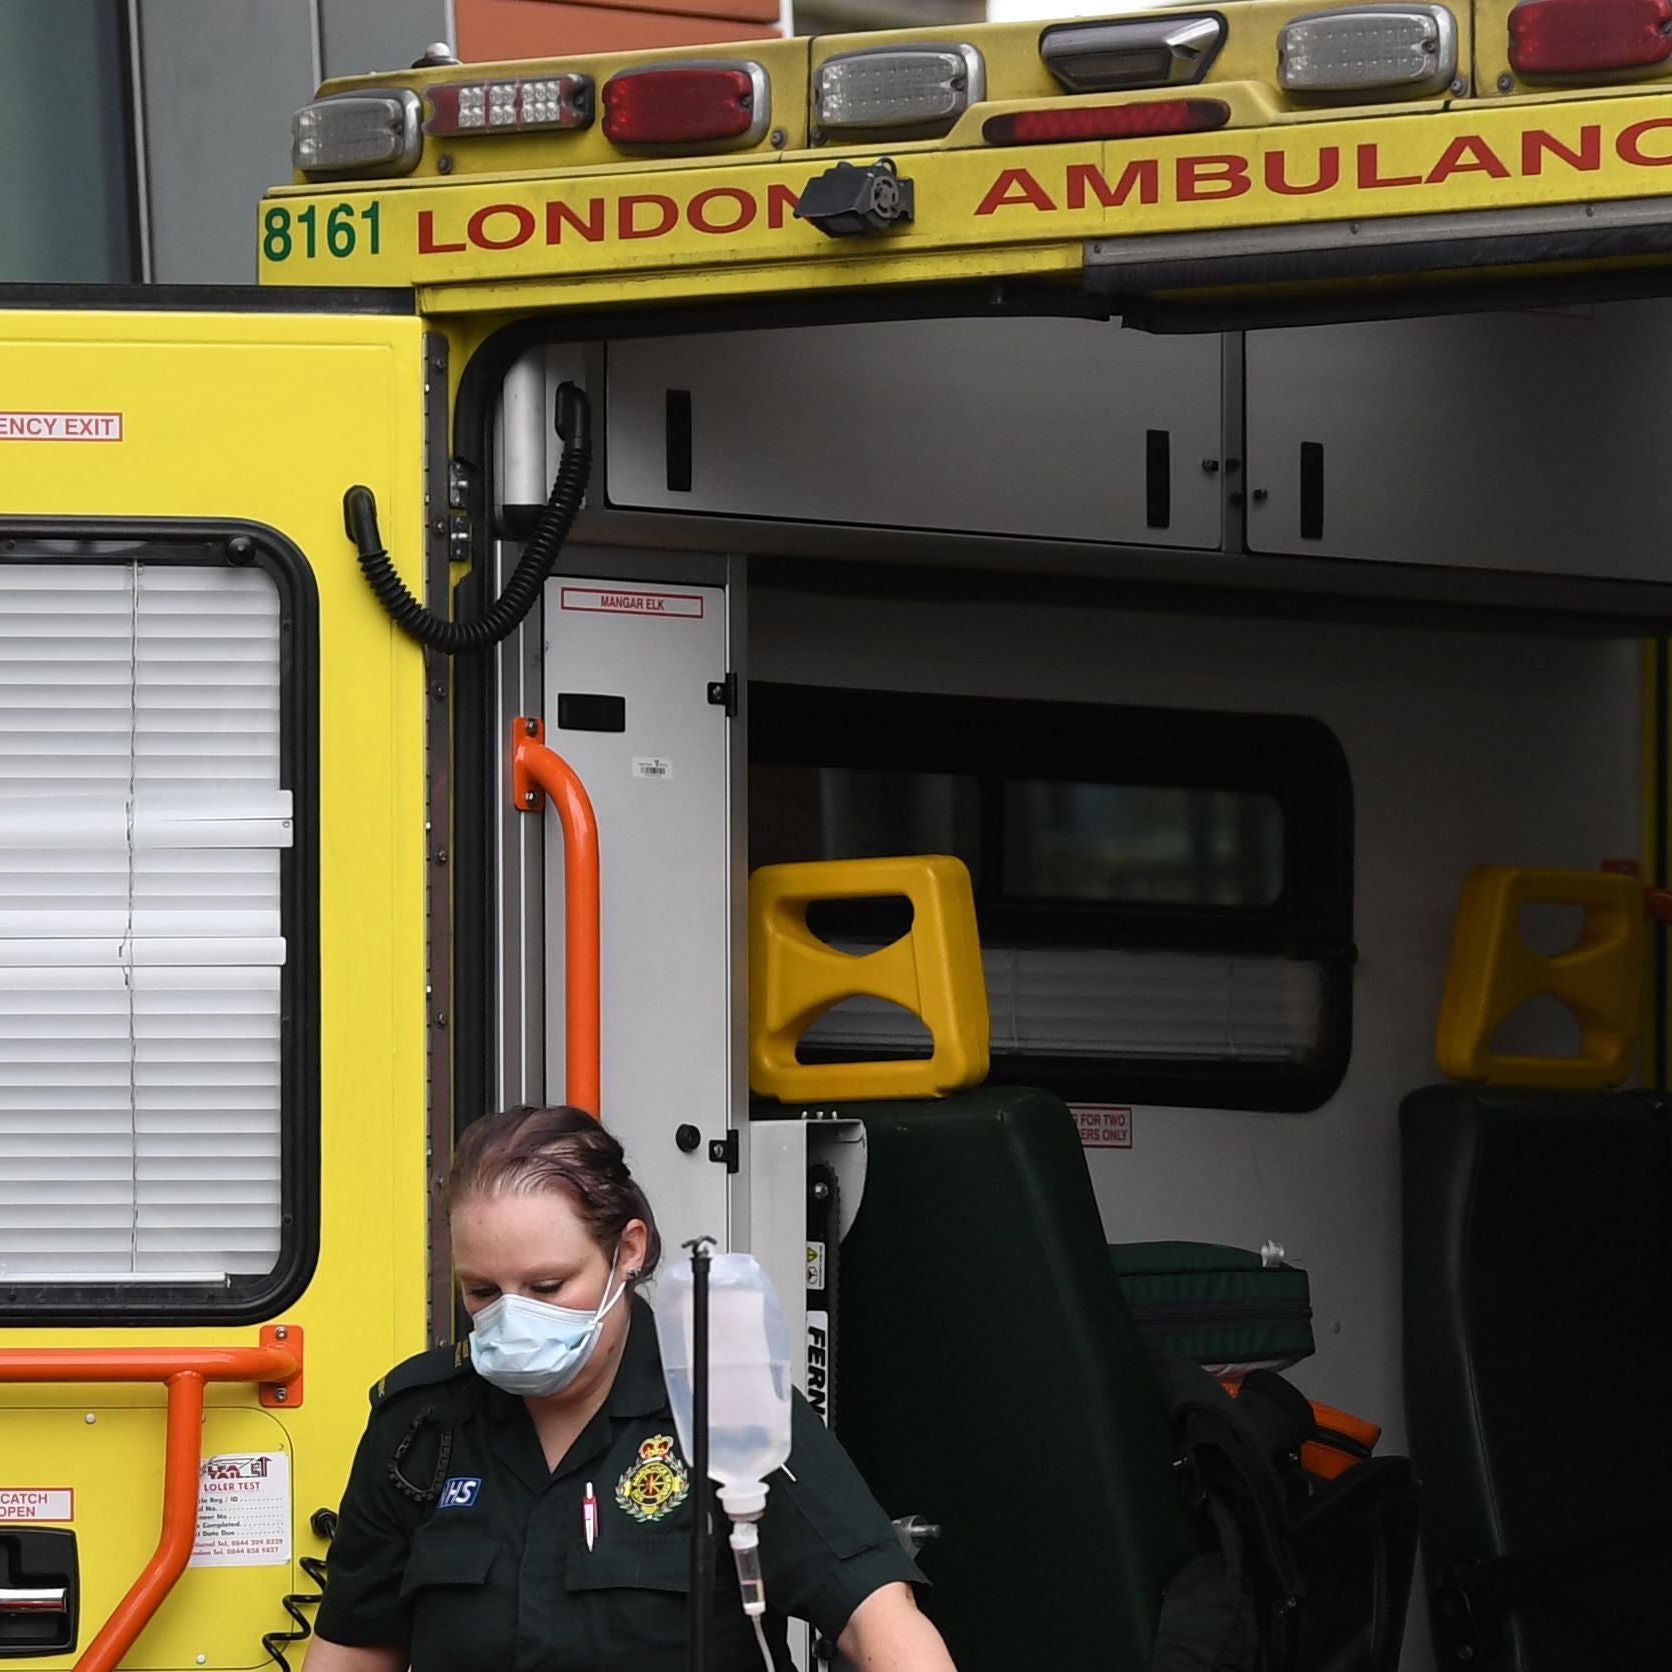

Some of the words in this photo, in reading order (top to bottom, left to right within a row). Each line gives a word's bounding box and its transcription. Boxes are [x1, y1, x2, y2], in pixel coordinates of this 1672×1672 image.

[263, 201, 382, 262] 8161
[65, 418, 114, 436] EXIT
[600, 595, 644, 610] MANGAR
[646, 598, 665, 611] ELK
[1081, 1114, 1101, 1126] FOR
[1103, 1114, 1126, 1126] TWO
[1081, 1128, 1100, 1140] ERS
[1102, 1129, 1128, 1140] ONLY
[807, 1325, 827, 1416] FERN
[204, 1483, 235, 1492] LOLER
[238, 1482, 261, 1491] TEST
[0, 1493, 48, 1504] CATCH
